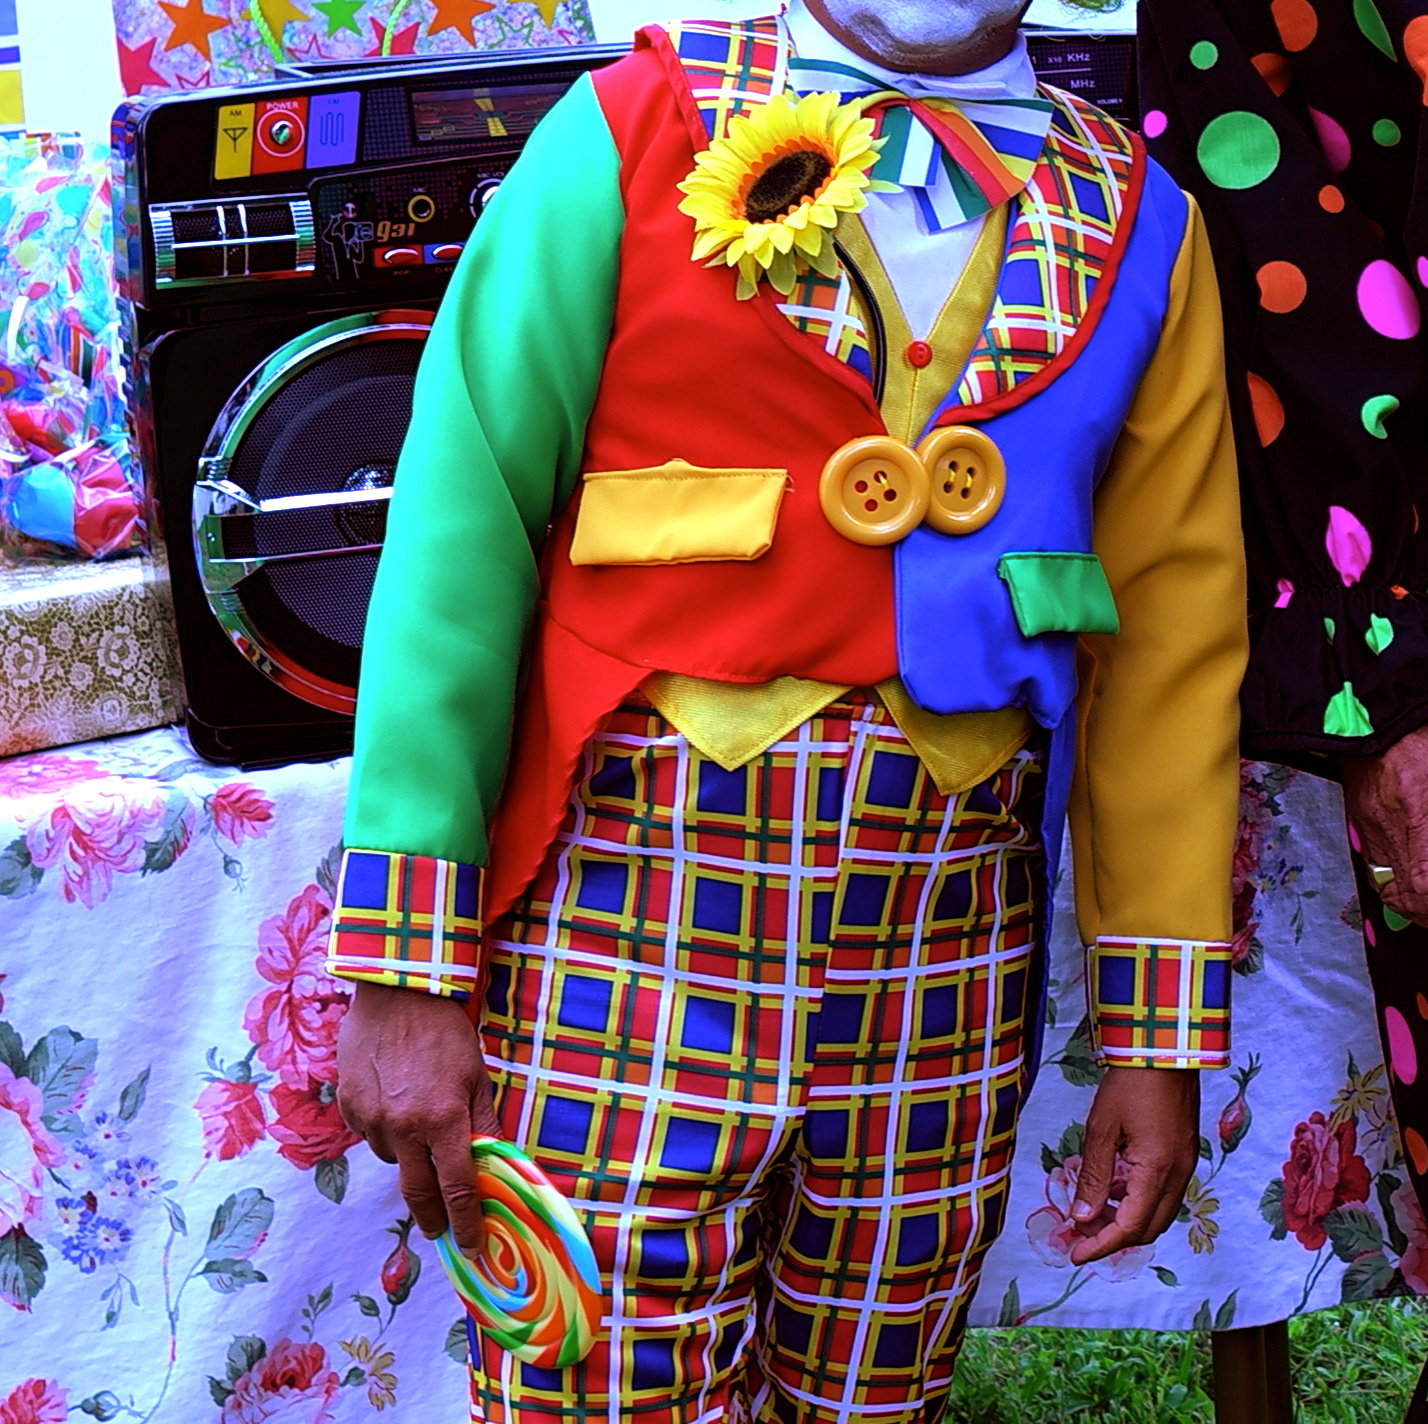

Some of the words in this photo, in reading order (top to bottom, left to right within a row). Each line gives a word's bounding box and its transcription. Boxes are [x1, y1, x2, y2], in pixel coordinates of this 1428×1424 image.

[1067, 52, 1091, 62] KHz
[1070, 79, 1096, 89] MHz
[266, 101, 299, 110] POWER
